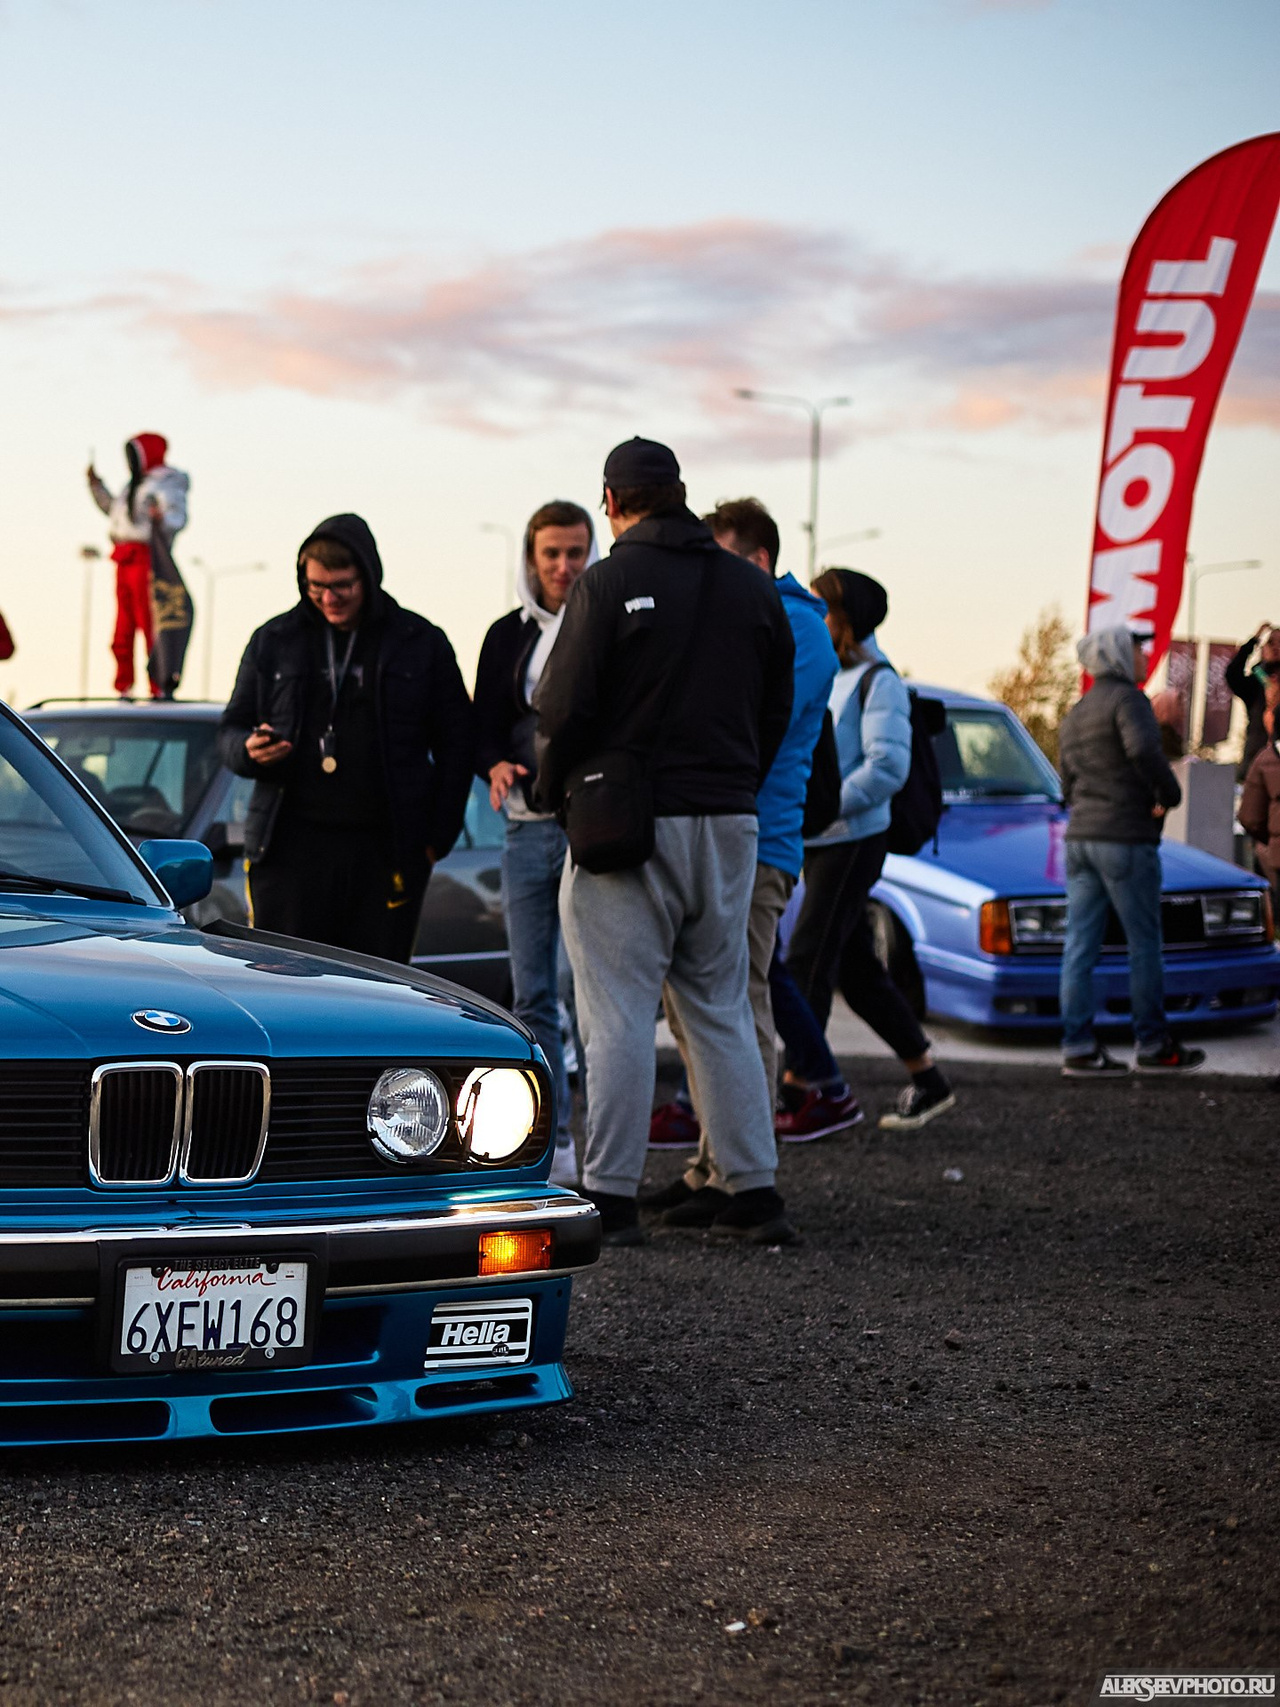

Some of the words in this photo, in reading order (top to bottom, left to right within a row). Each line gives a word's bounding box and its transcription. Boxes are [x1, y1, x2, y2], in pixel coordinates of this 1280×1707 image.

[1088, 235, 1238, 654] MOTUL
[157, 1267, 276, 1297] California
[126, 1296, 298, 1354] 6XEW168
[440, 1321, 510, 1346] Hella
